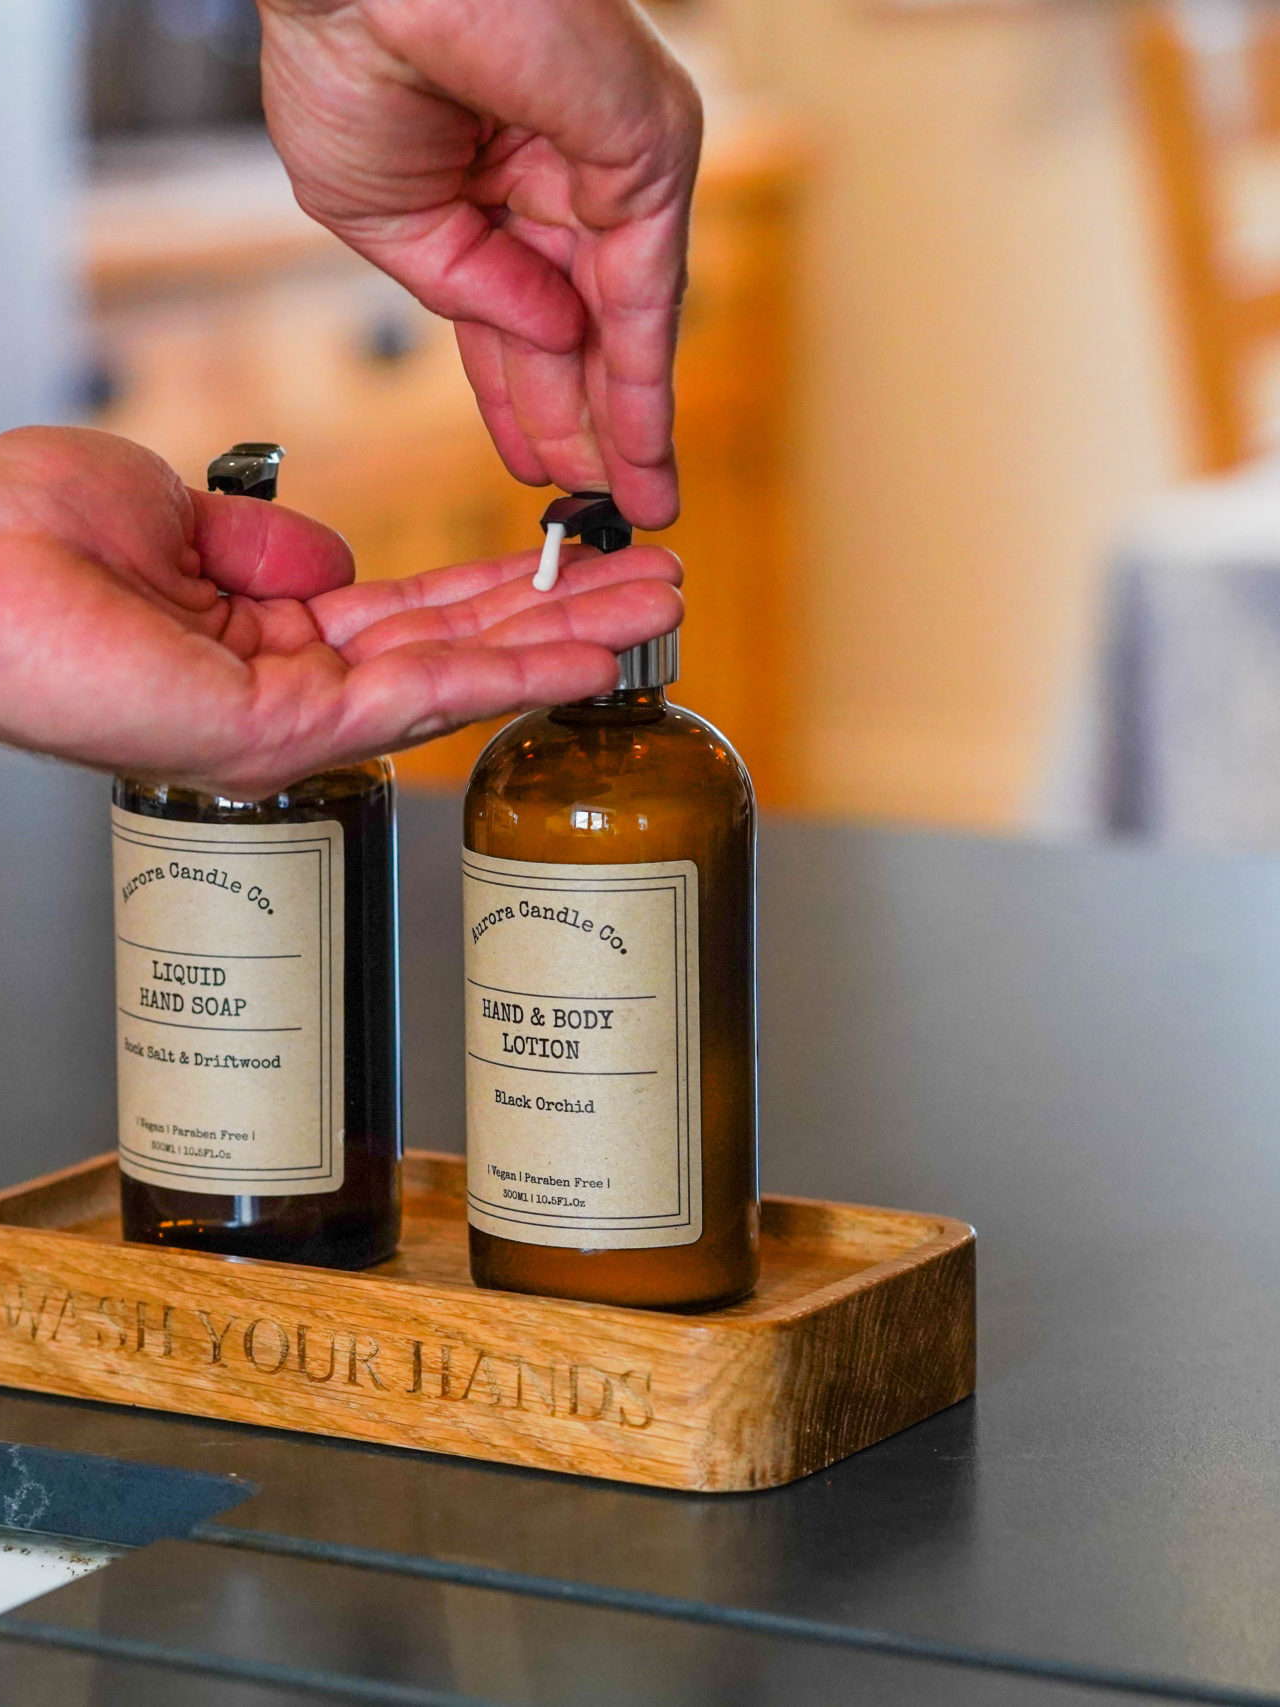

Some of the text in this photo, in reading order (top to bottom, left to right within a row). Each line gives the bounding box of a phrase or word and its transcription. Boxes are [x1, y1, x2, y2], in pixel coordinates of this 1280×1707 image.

[122, 862, 274, 915] Aurora Candle Co.
[471, 901, 627, 955] Aurora Candle Co.
[152, 960, 226, 986] LIQUID
[140, 987, 247, 1016] HAND SOAP
[482, 998, 614, 1029] HAND & BODY
[147, 1046, 175, 1063] Salt
[179, 1051, 189, 1065] &
[194, 1052, 281, 1069] Driftwood
[502, 1032, 580, 1059] LOTION
[494, 1089, 595, 1114] Black Orchid
[141, 1118, 248, 1141] Vegan Paraben Free
[491, 1165, 603, 1188] Vegan Paraben Free
[0, 1283, 654, 1430] WASH YOUR HANDS
